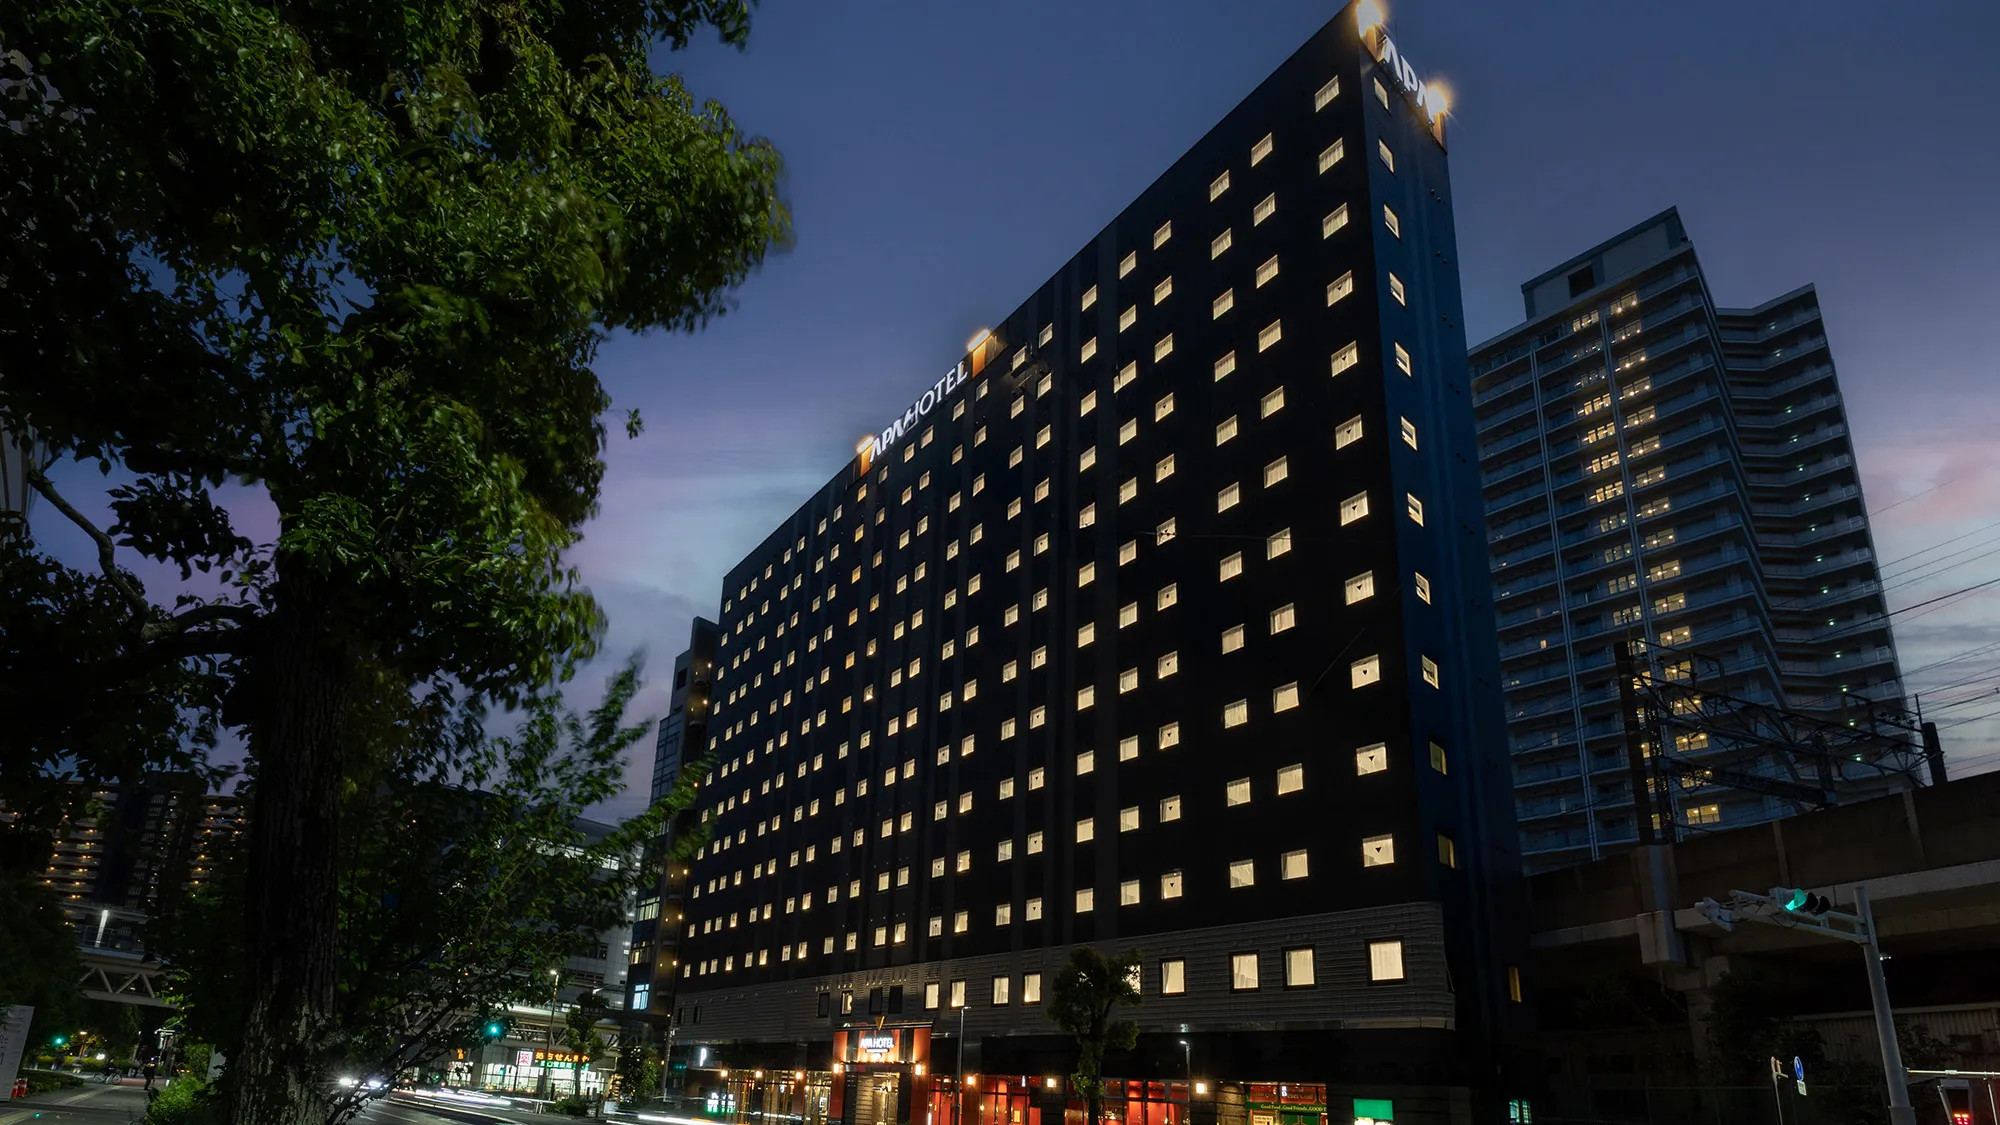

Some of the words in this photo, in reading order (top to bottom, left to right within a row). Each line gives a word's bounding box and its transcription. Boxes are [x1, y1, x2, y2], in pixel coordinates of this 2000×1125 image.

[869, 418, 904, 463] APA
[903, 360, 968, 429] HOTEL
[873, 1037, 894, 1048] HOTEL
[700, 1048, 707, 1067] P
